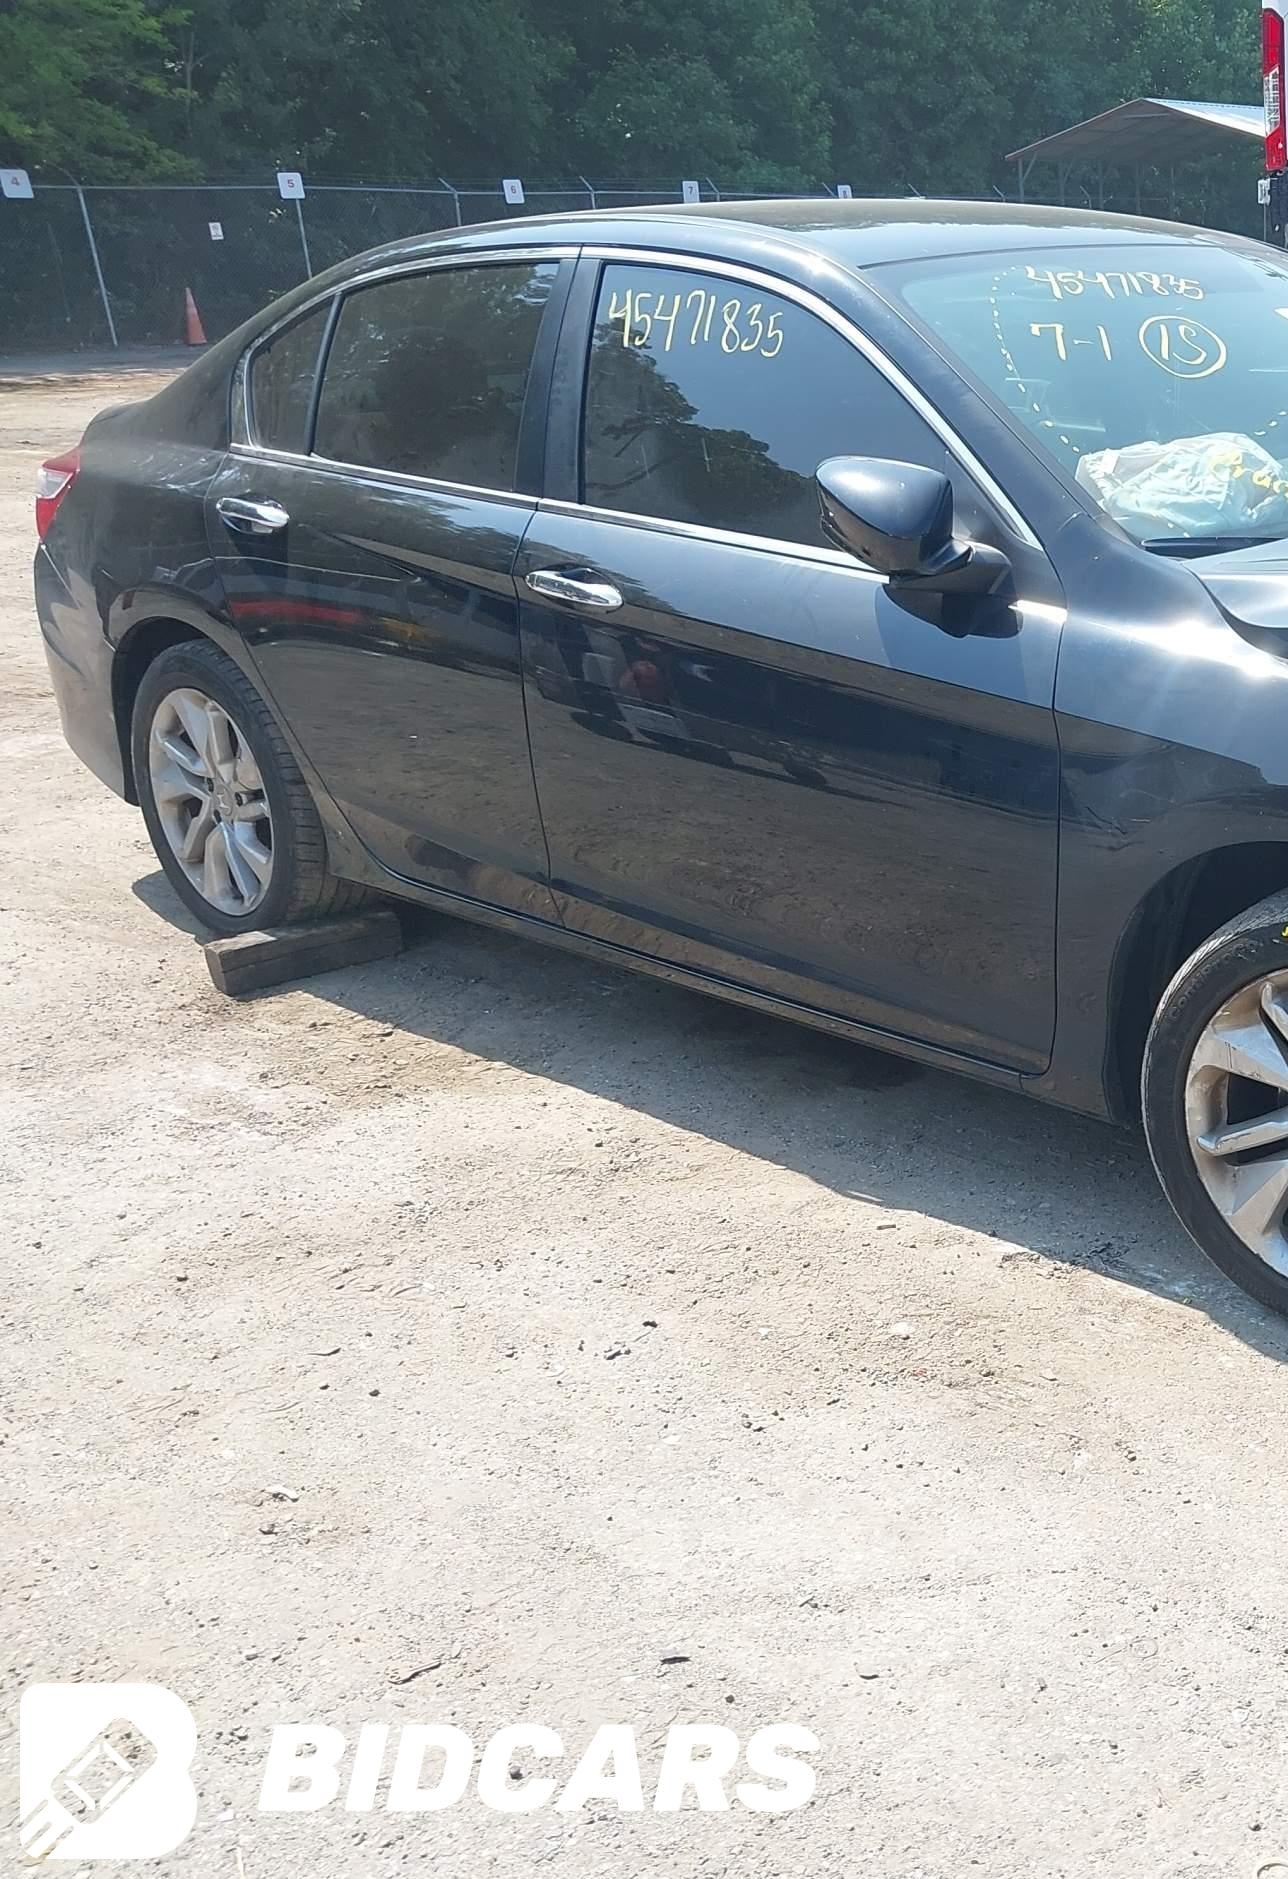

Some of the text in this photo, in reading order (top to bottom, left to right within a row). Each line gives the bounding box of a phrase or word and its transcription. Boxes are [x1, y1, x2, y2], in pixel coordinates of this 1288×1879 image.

[11, 176, 20, 187] 4
[287, 179, 295, 188] 5
[510, 185, 517, 194] 6
[687, 186, 694, 195] 7
[1024, 265, 1206, 301] 45471835
[608, 288, 784, 358] 45471835
[1029, 322, 1113, 362] 7-1
